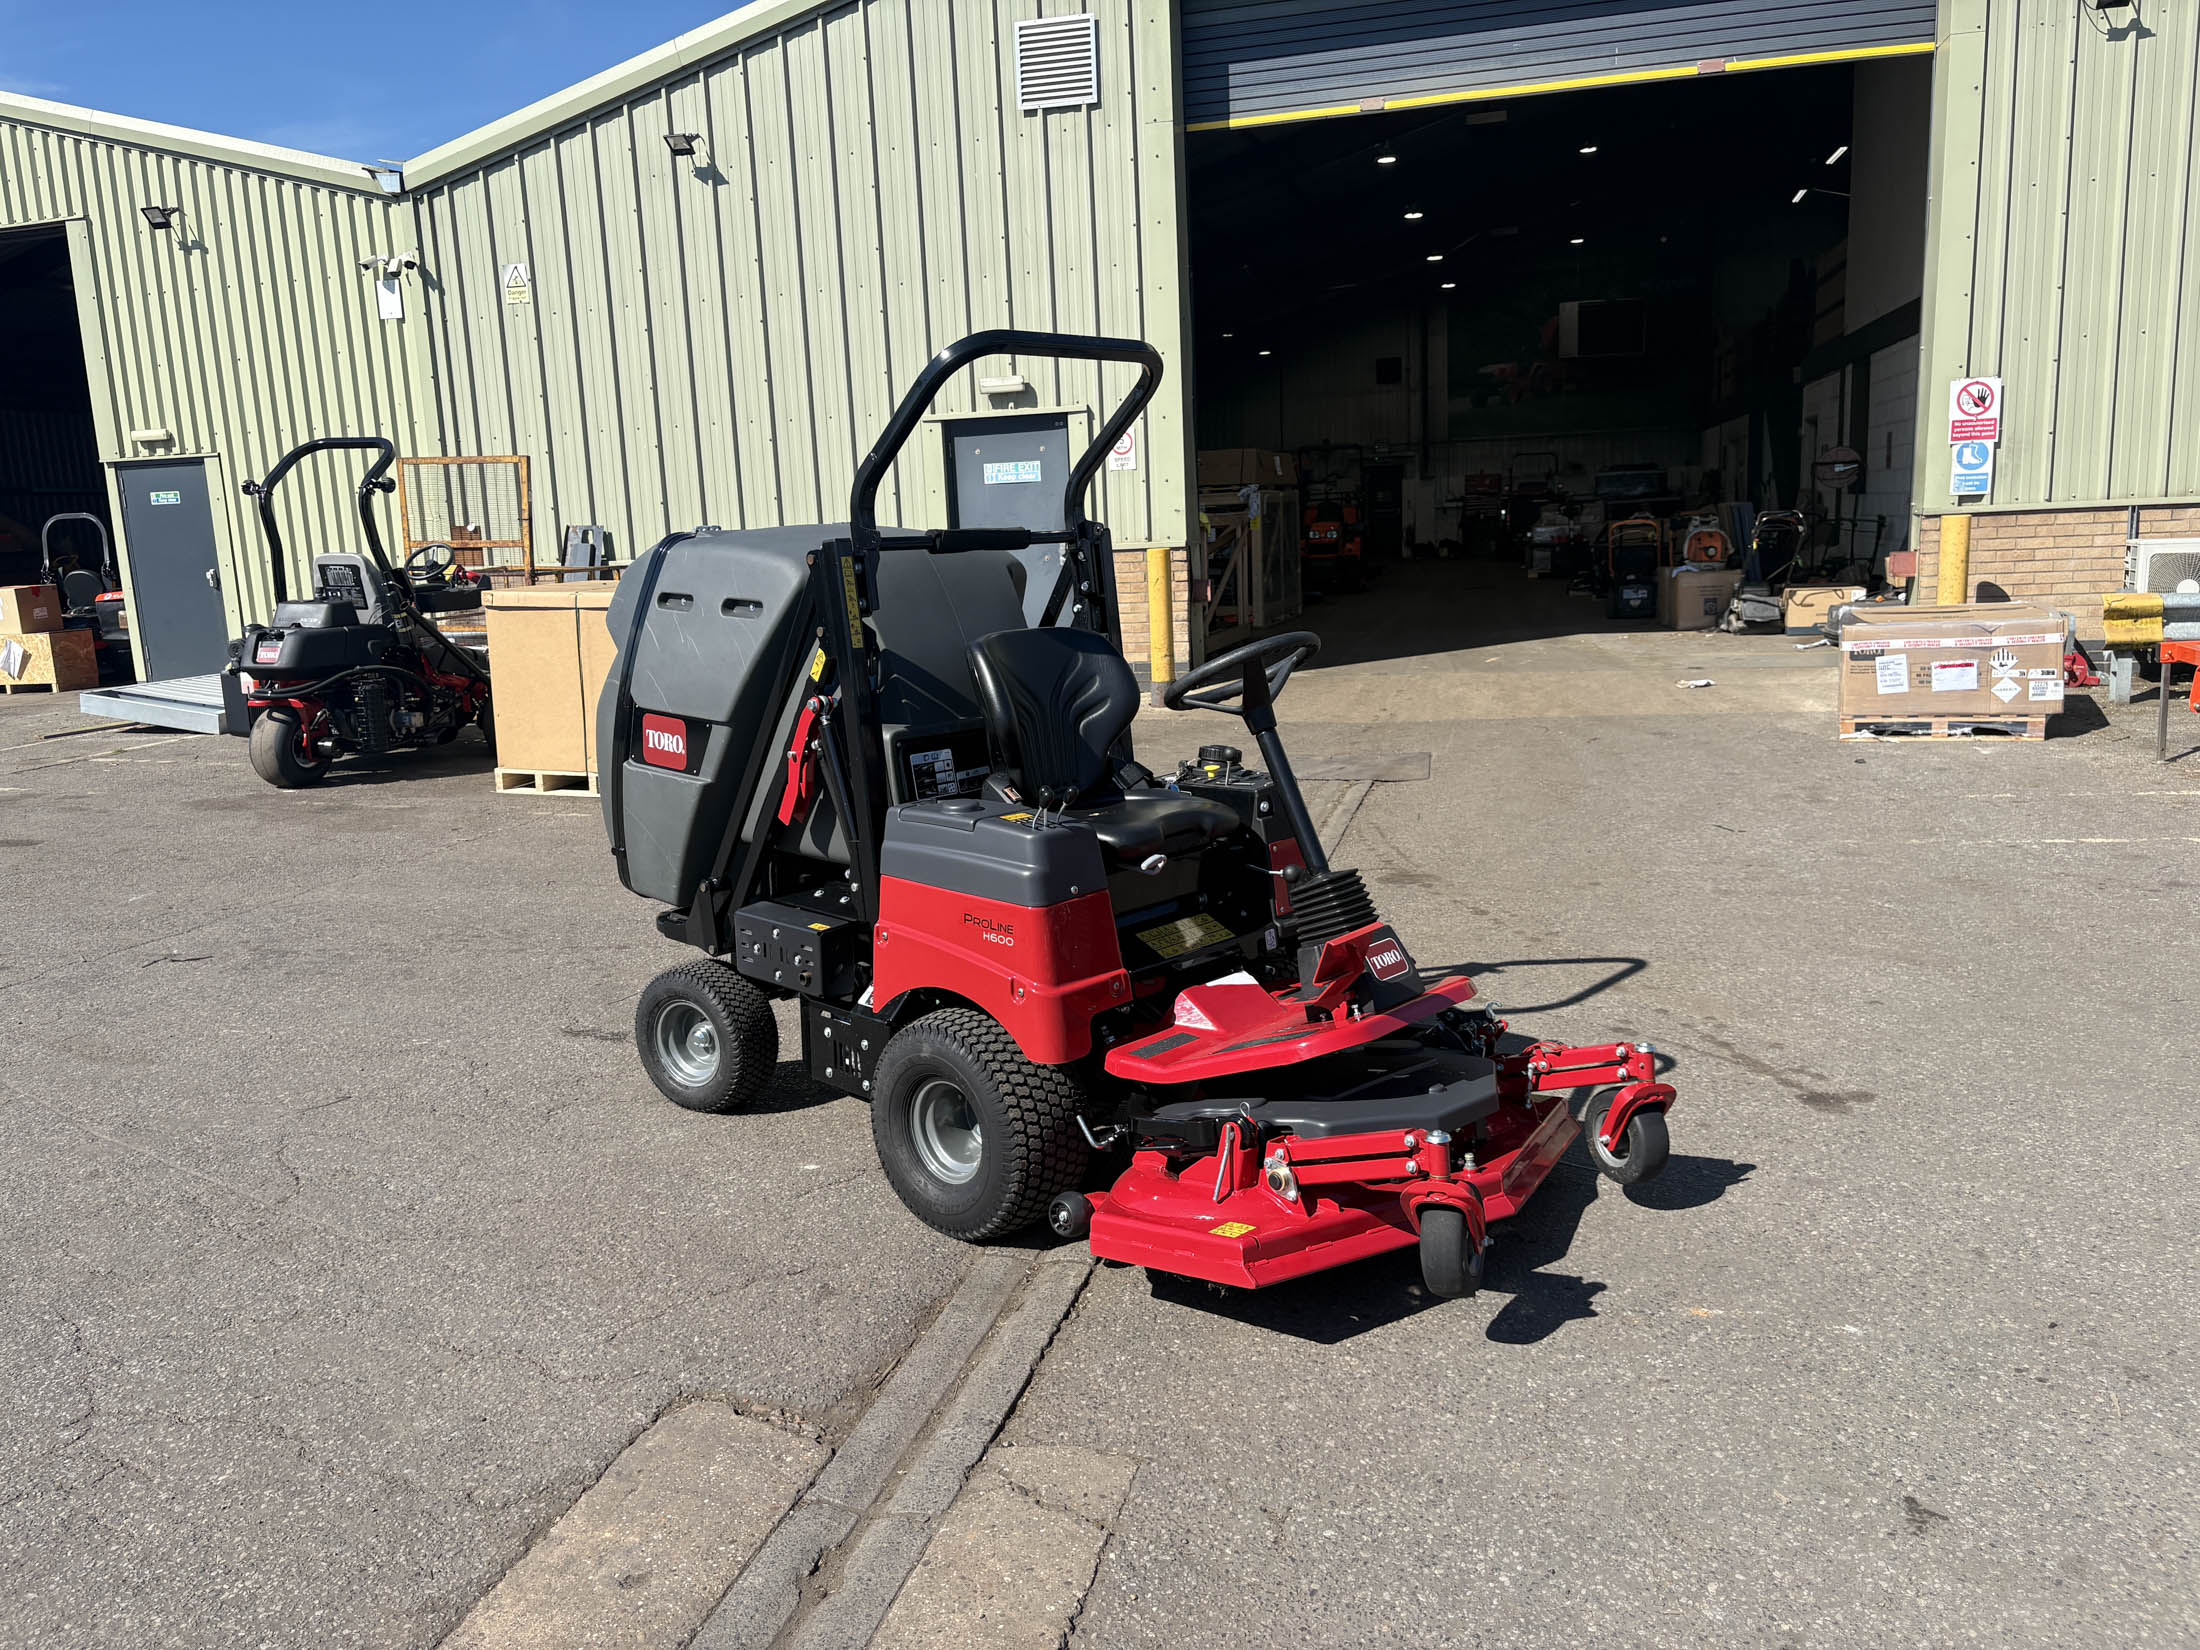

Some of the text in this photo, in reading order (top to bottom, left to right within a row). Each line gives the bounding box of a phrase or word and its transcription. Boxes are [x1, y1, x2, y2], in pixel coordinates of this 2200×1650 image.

[994, 461, 1040, 473] FIRE EXIT
[645, 728, 684, 755] TORO
[983, 931, 1014, 947] H600
[1370, 949, 1401, 970] TORO
